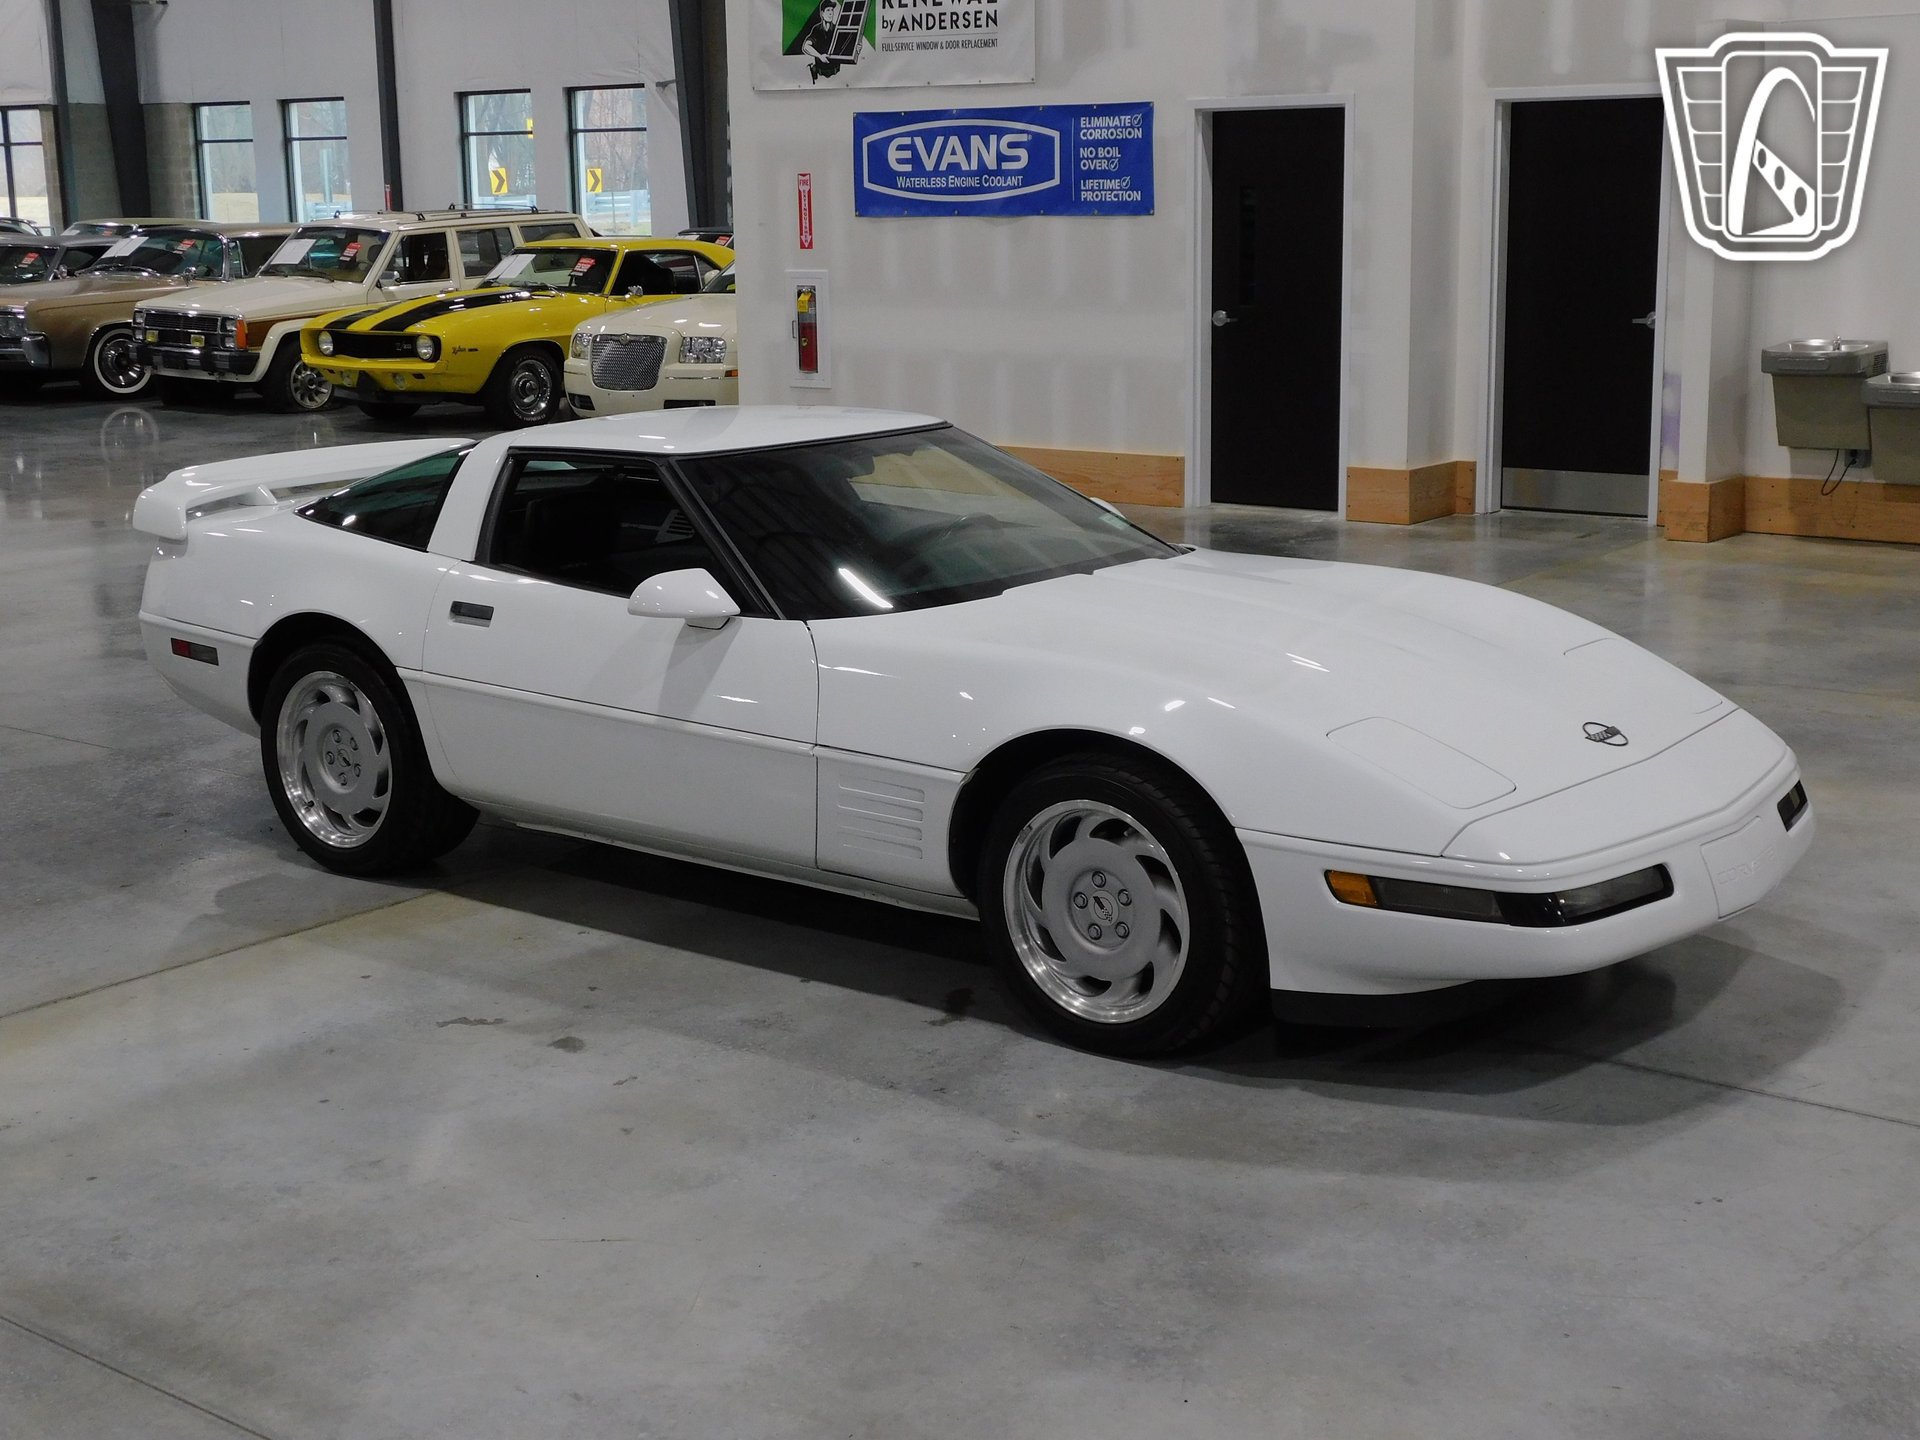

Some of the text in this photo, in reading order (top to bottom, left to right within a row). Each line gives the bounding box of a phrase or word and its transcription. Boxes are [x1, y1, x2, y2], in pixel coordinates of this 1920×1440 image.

[882, 10, 998, 32] by ANDERSEN
[916, 41, 940, 50] WINDOW
[945, 40, 960, 49] DOOR
[961, 38, 998, 49] REPLACEMENT
[1080, 115, 1131, 128] ELIMINATE
[1080, 128, 1142, 140] CORROSION
[887, 133, 1029, 172] EVANS
[1080, 146, 1121, 158] NO BOIL
[1080, 159, 1109, 170] OVER
[896, 174, 1023, 188] WATERLESS ENGINE COOLANT
[1080, 179, 1121, 190] LIFETIME
[1081, 190, 1141, 201] PROTECTION
